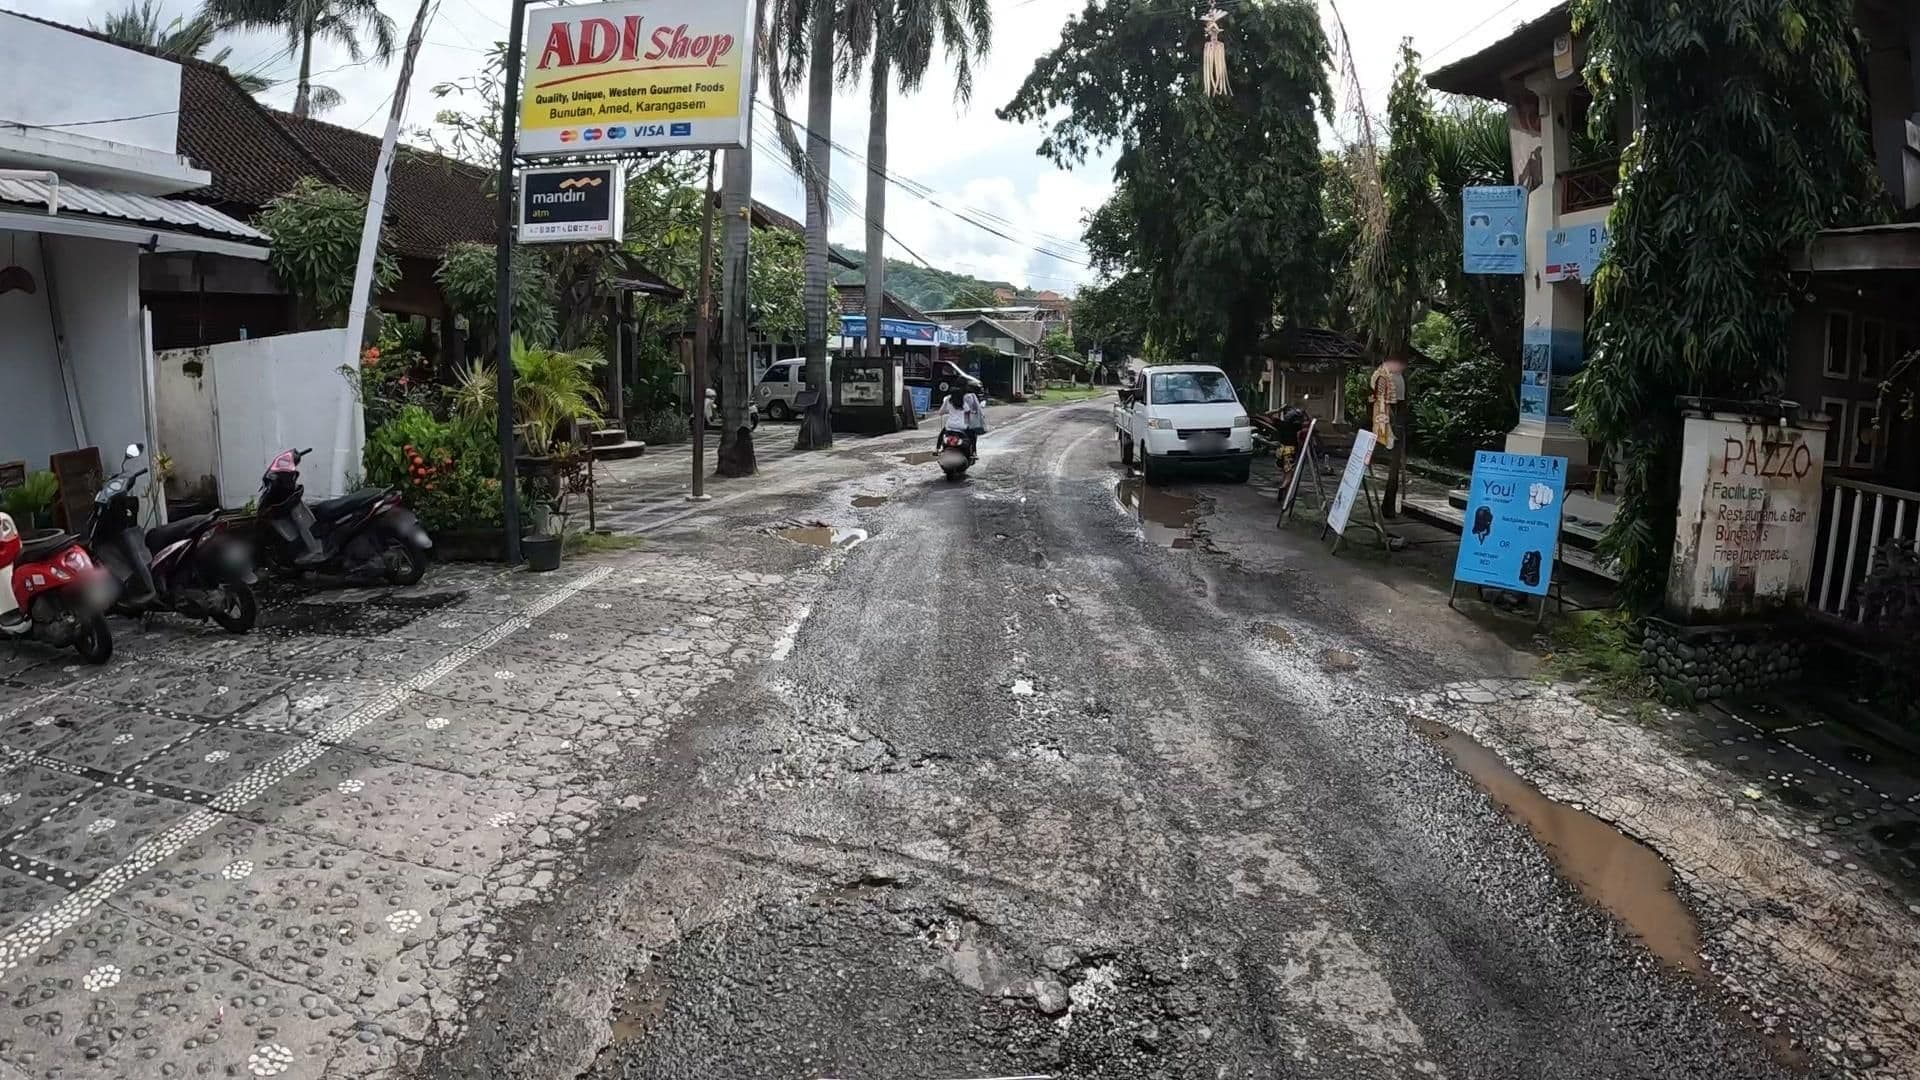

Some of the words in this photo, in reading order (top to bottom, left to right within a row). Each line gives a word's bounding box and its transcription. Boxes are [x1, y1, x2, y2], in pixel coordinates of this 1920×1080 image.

[536, 15, 645, 70] ADI
[644, 23, 735, 68] Shop
[535, 93, 569, 105] Quality,
[571, 89, 606, 102] Unique,
[608, 85, 647, 98] Western
[649, 83, 693, 96] Gourmet
[695, 81, 725, 93] Foods
[549, 106, 595, 120] Bunutan,
[598, 102, 633, 115] Amed,
[636, 100, 706, 114] Karangasem
[633, 124, 665, 138] VISA
[532, 188, 586, 204] mandiri
[532, 208, 550, 218] atm
[1480, 453, 1547, 469] BALIDAS
[1721, 434, 1813, 479] PAZZO
[1482, 479, 1517, 498] You!
[1718, 503, 1779, 522] Restaurant
[1789, 507, 1807, 523] Bar
[1499, 540, 1511, 549] OR
[1713, 545, 1739, 562] Free
[1739, 545, 1782, 564] Internet
